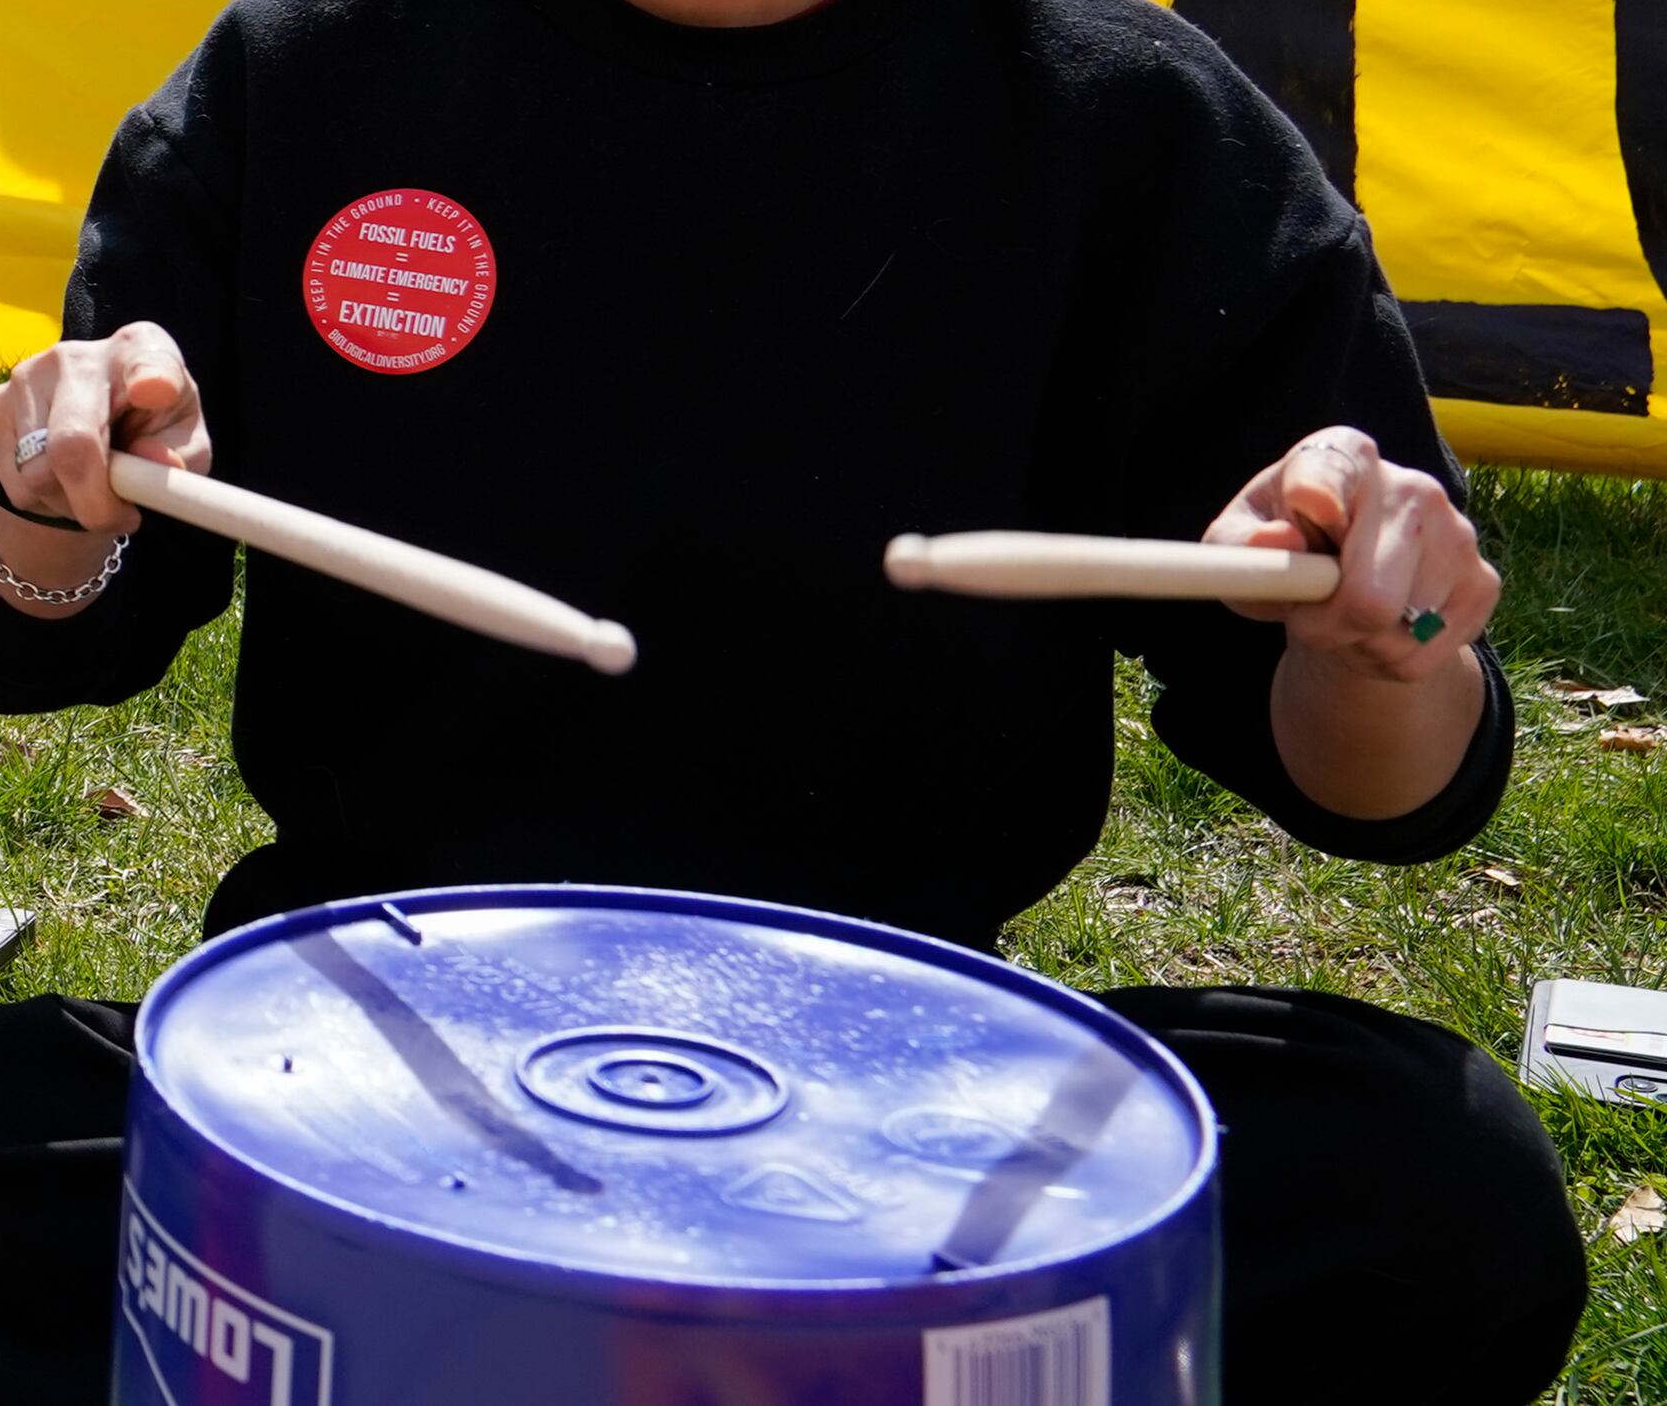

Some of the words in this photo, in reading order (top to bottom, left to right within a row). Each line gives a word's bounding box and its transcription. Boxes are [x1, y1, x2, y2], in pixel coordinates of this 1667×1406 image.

[350, 193, 403, 221] GROUND
[426, 197, 460, 221] KEEP
[326, 216, 352, 240] THE
[358, 221, 407, 247] FOSSIL
[409, 230, 456, 254] FUELS
[456, 219, 474, 234] IT
[316, 243, 333, 257] IN
[466, 235, 483, 251] IN
[310, 260, 324, 273] IT
[329, 258, 386, 284] CLIMATE
[387, 268, 469, 297] EMERGENCY
[473, 251, 490, 277] THE
[310, 279, 328, 312] KEEP
[456, 283, 490, 334] GROUND
[338, 300, 447, 339] EXTINCTION
[327, 327, 447, 370] BIOLOGICALDIVERSITY.ORG
[127, 1212, 294, 1406] LOWE'S
